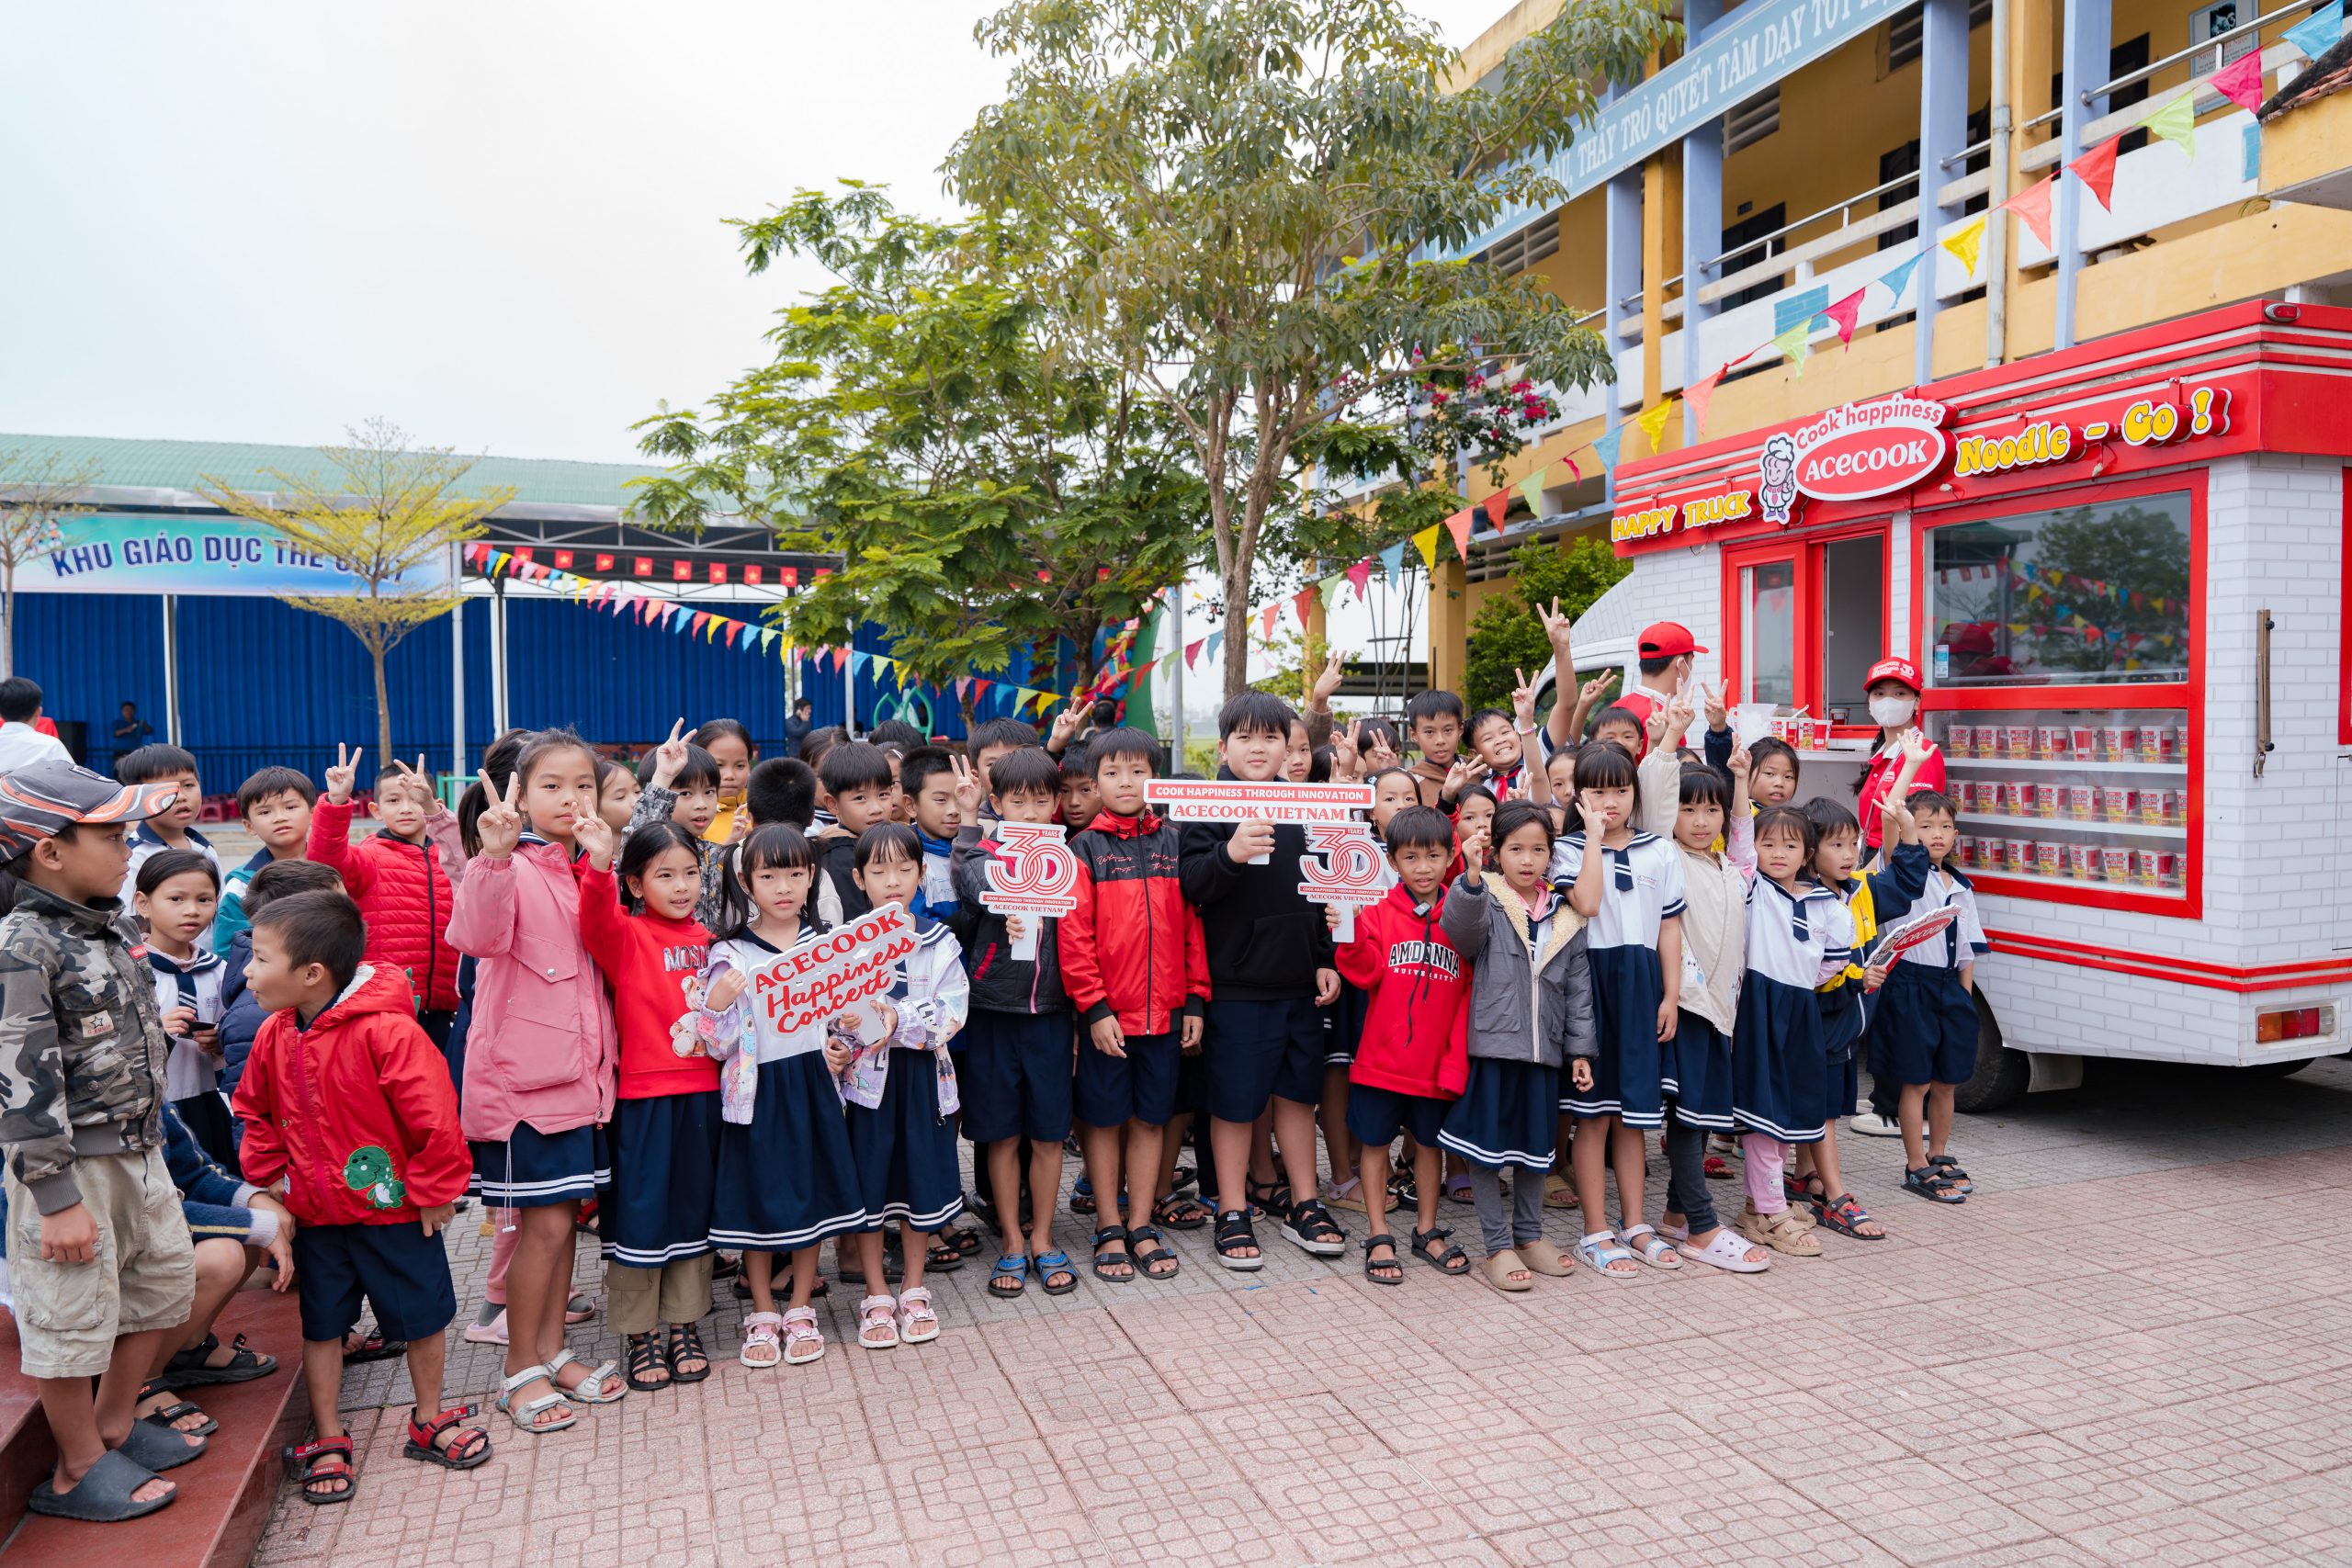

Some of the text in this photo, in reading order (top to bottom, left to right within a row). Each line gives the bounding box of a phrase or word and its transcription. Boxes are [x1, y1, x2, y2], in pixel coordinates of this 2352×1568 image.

[1577, 118, 1617, 177] THẦY
[1621, 95, 1651, 152] TRÒ
[1656, 57, 1712, 135] QUYẾT
[1717, 33, 1758, 94] TÂM
[1764, 4, 1806, 67] DẠY
[1797, 398, 1941, 449] Cook happiness
[1956, 424, 2068, 474] Noodle
[2124, 403, 2176, 443] Go
[1612, 492, 1750, 540] HAPPY TRUCK
[51, 543, 113, 577] KHU
[124, 532, 192, 566] GIÁO
[205, 536, 262, 568] DỤC
[1156, 786, 1363, 801] COOK HAPPINESS THROUGH INNOVATION
[1174, 805, 1345, 820] ACECOOK VIETNAM
[990, 827, 1073, 895] 30
[1304, 827, 1381, 886] 30
[755, 909, 904, 994] ACECOOK
[767, 937, 915, 1018] Happiness
[777, 969, 891, 1032] Concert
